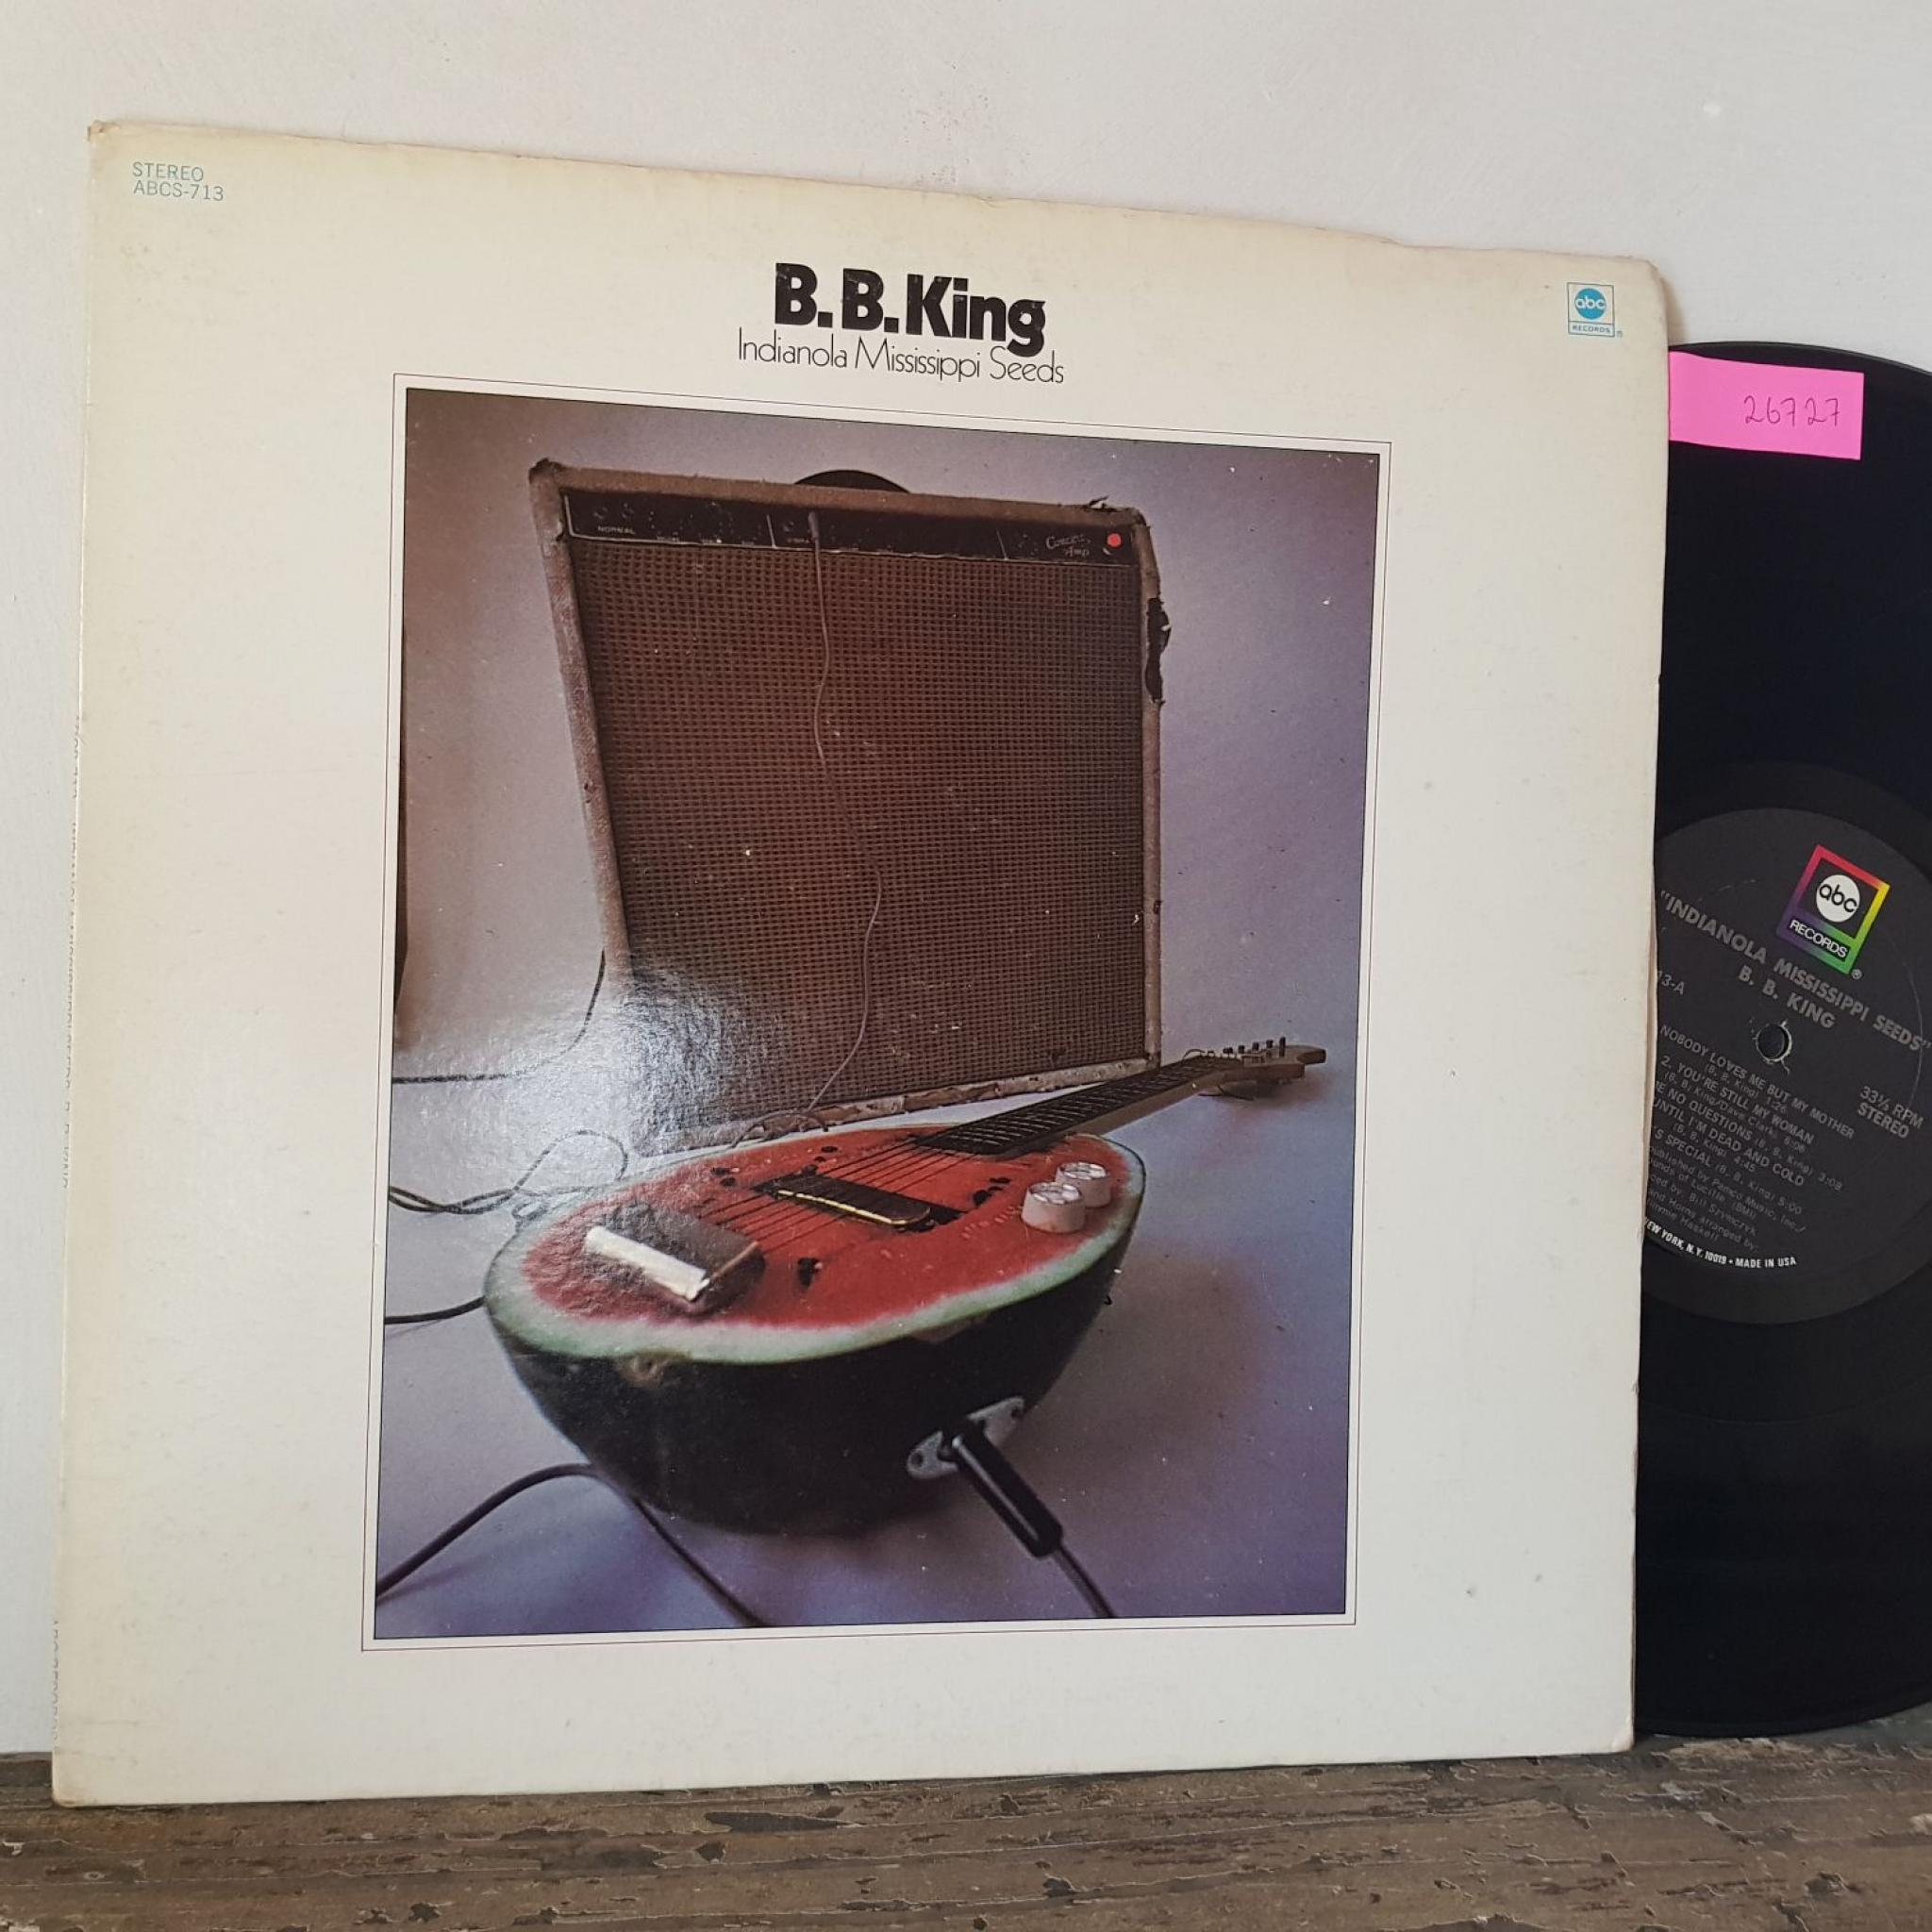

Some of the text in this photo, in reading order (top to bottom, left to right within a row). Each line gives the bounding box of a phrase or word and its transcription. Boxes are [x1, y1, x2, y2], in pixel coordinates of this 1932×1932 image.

[132, 161, 204, 182] STEREO
[133, 179, 224, 201] ABCS-713
[1574, 294, 1607, 309] abc
[1572, 325, 1611, 333] RECORDS
[739, 326, 1065, 384] Indianola Mississippi Seeds
[1743, 394, 1840, 426] 26727
[1818, 883, 1858, 913] abc
[1659, 891, 1767, 964] "INDIANOLA
[1773, 957, 1870, 1021] MISSISSIPPI
[1789, 919, 1848, 958] RECORDS
[1786, 991, 1837, 1029] KING
[1659, 1024, 1856, 1139] NOBODY LOVES ME BUT MY MOTHER
[1666, 1088, 1687, 1105] NO
[1688, 1099, 1753, 1141] QUESTIONS
[1675, 1062, 1719, 1091] YOU'RE
[1719, 1086, 1752, 1109] STILL
[1752, 1105, 1770, 1119] MY
[1770, 1114, 1814, 1144] WOMAN
[1857, 1101, 1909, 1139] STEREO
[1891, 1103, 1924, 1128] RPM
[1664, 1134, 1714, 1166] SPECIAL
[1687, 1116, 1707, 1132] I'M
[1707, 1127, 1742, 1152] DEAD
[1742, 1146, 1771, 1168] AND
[1771, 1162, 1806, 1187] COLD
[1644, 1221, 1662, 1235] EW
[1660, 1228, 1685, 1252] YORK,
[1735, 1257, 1762, 1269] MADE
[1765, 1257, 1774, 1268] IN
[1778, 1257, 1797, 1268] USA
